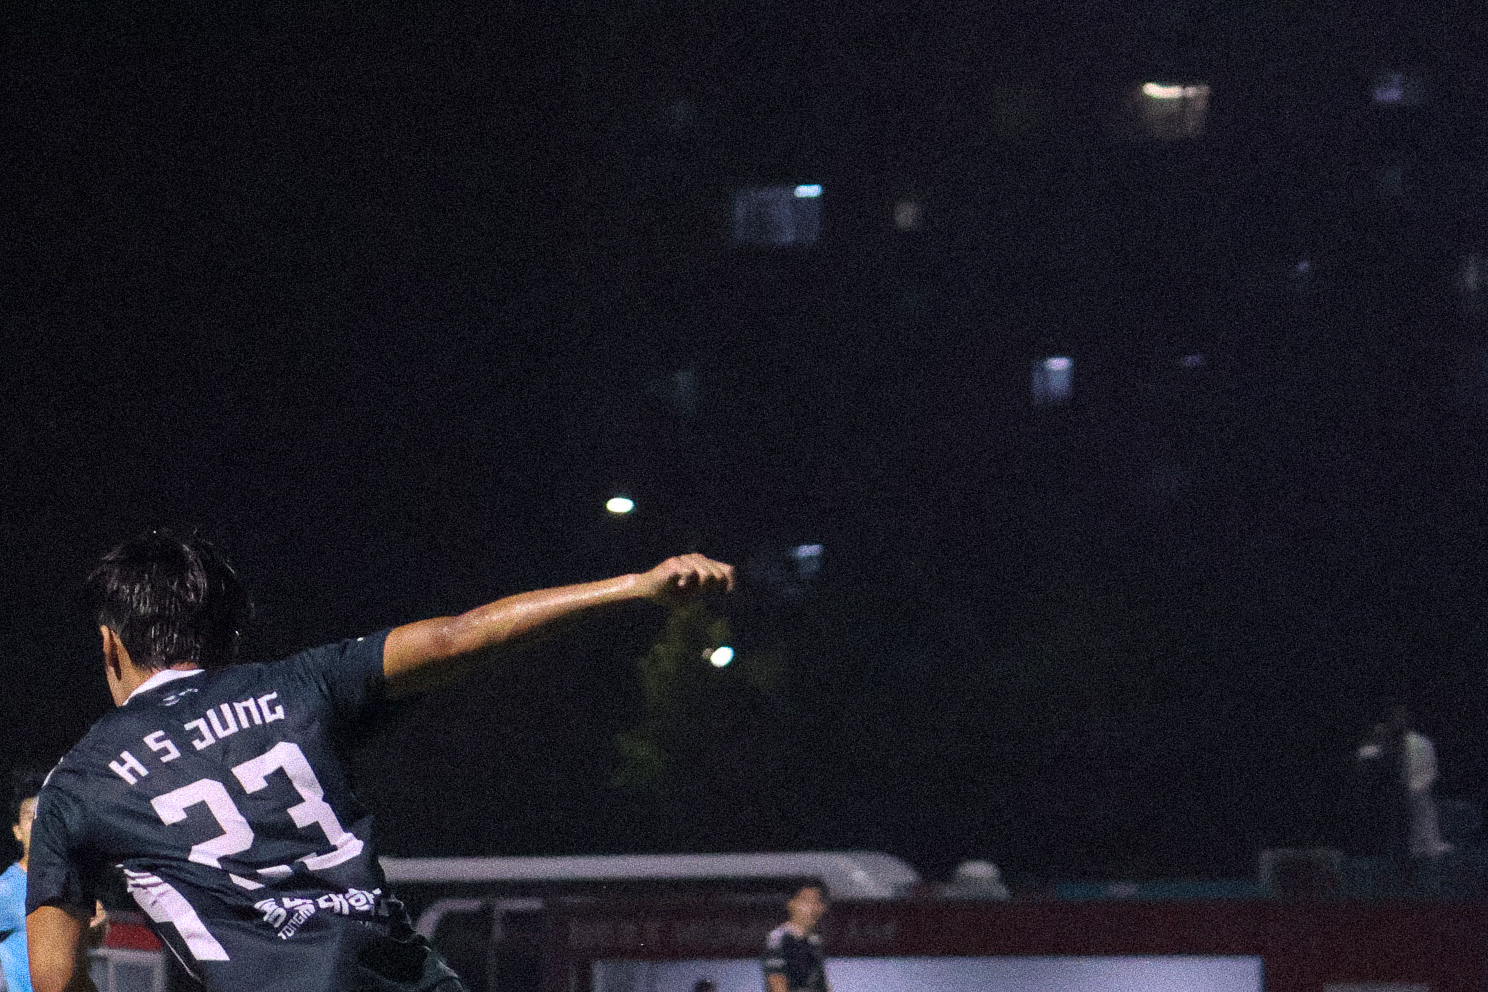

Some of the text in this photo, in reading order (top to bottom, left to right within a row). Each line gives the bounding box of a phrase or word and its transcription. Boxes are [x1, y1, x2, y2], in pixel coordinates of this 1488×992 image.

[108, 691, 285, 785] H S JUNG
[150, 741, 364, 890] 23
